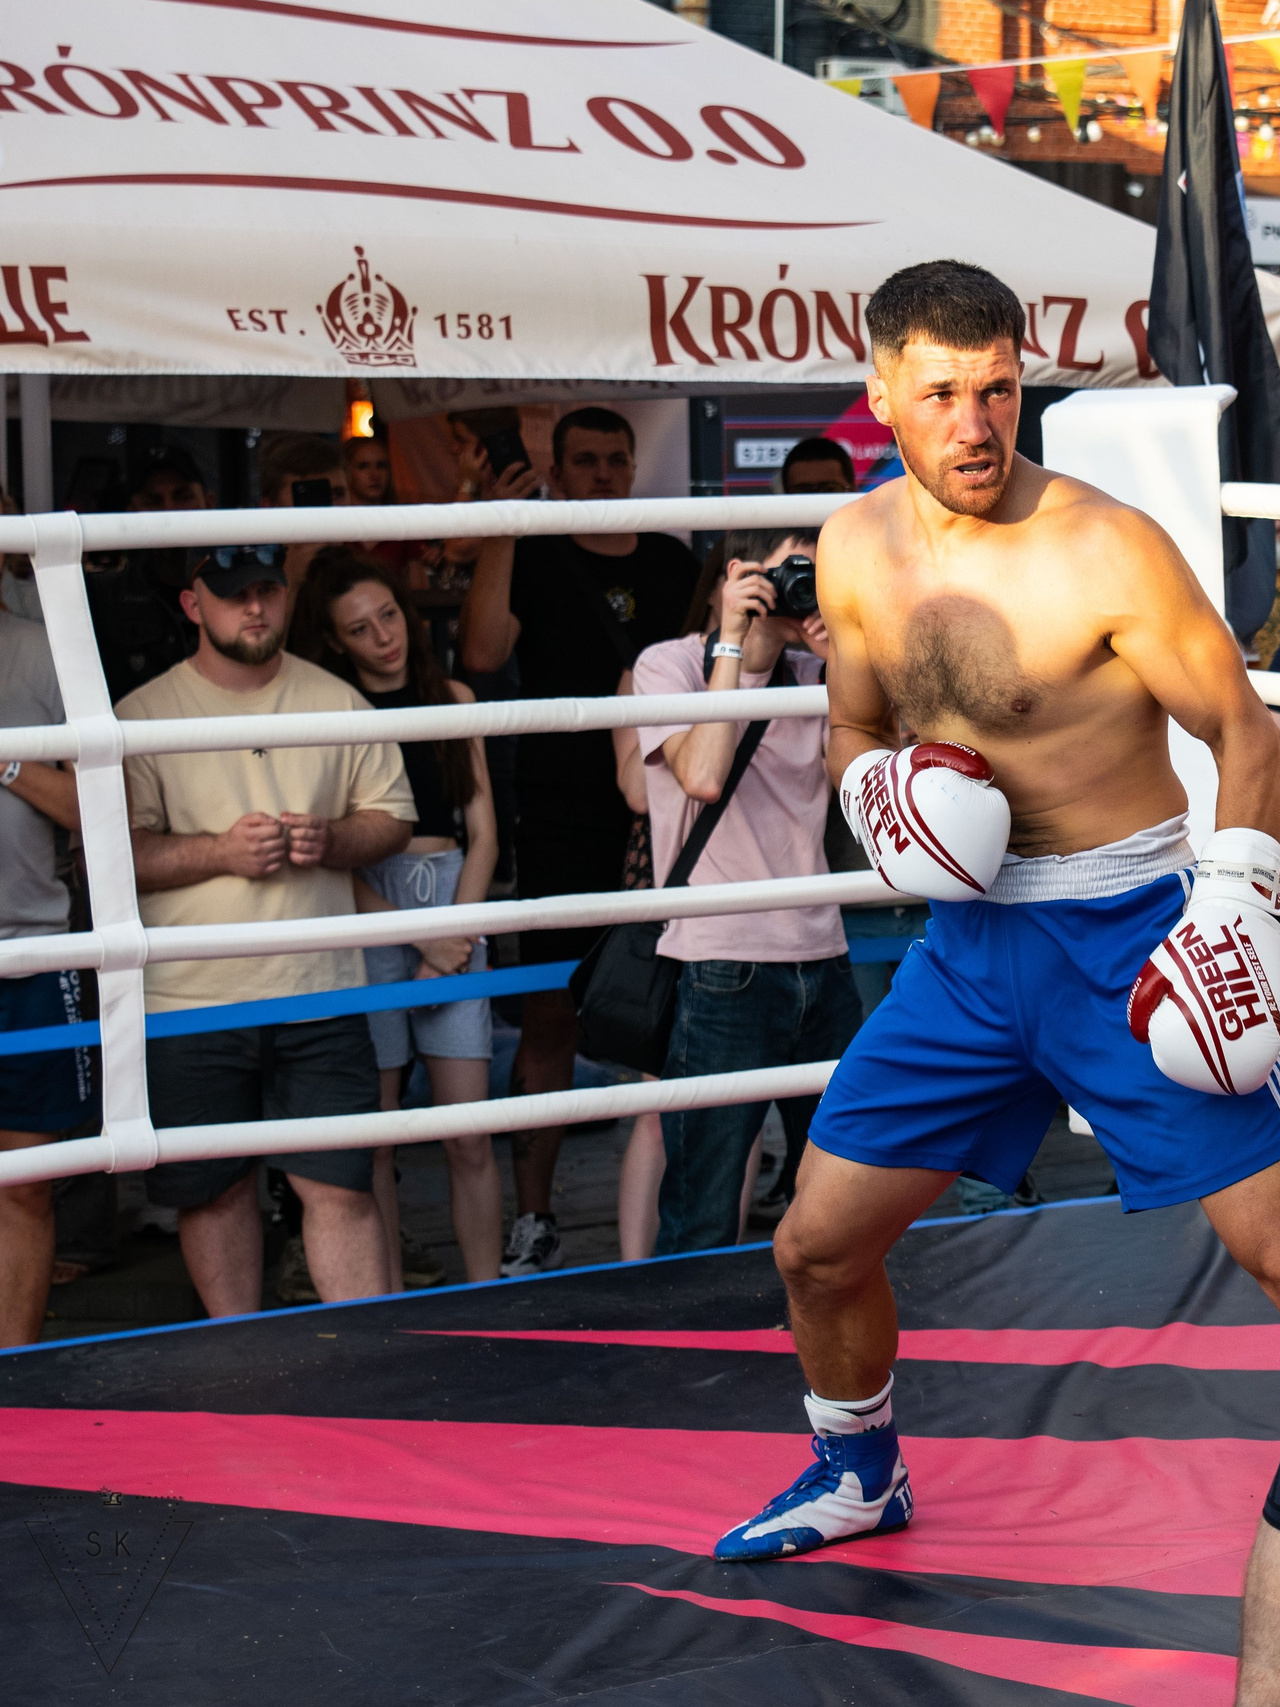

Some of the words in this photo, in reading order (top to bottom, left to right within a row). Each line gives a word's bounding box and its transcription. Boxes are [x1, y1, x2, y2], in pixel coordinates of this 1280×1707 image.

[0, 45, 582, 154] RÓNPRINZ
[226, 308, 307, 336] EST.
[433, 313, 514, 341] 1581
[861, 765, 882, 857] HILL
[872, 753, 911, 855] GREEN
[1176, 921, 1244, 1041] GREEN
[1211, 924, 1269, 1030] HILL
[1243, 942, 1257, 960] SELF
[1252, 961, 1266, 980] BEST
